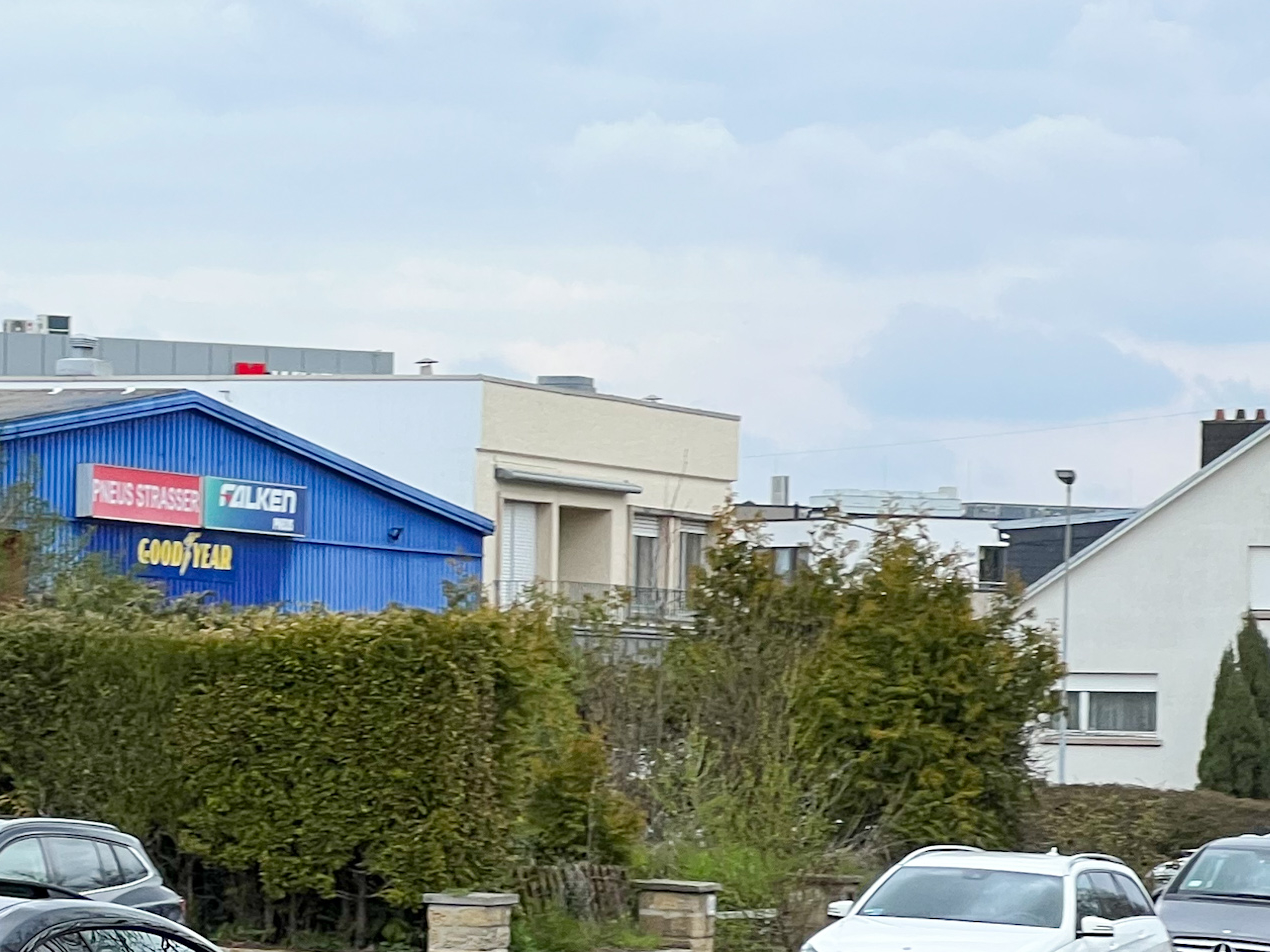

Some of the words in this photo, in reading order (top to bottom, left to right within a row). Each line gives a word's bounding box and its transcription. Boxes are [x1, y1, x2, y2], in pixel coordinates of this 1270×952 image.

[92, 479, 134, 506] PNEUS
[136, 483, 200, 513] STRASSER
[219, 483, 297, 514] FALKEN
